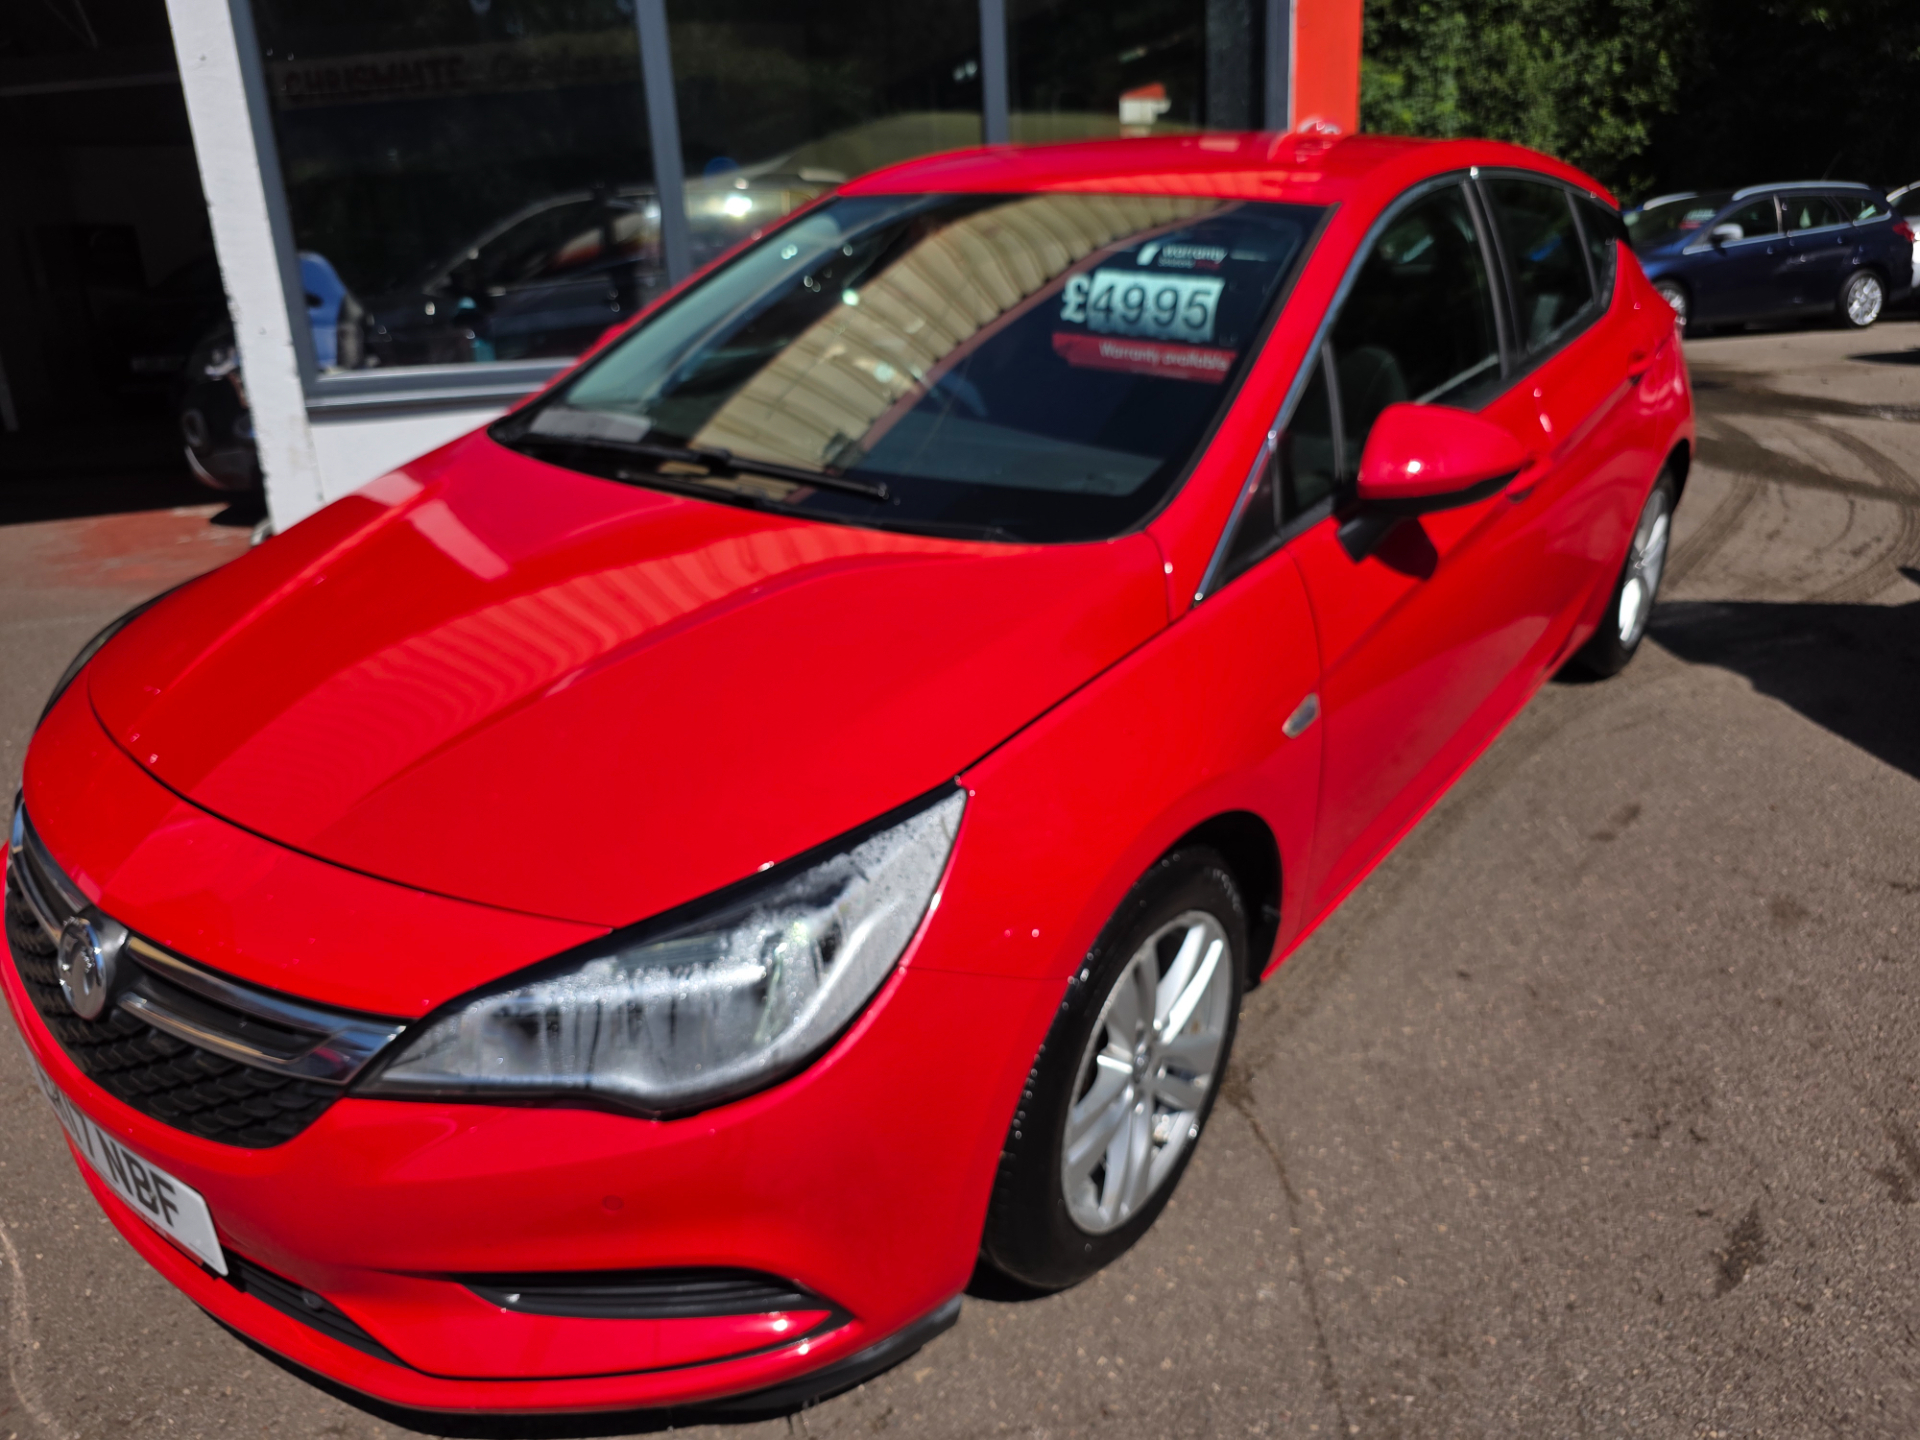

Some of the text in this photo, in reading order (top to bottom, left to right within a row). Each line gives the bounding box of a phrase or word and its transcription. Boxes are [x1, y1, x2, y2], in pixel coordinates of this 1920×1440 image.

[1059, 272, 1213, 330] £4995
[1099, 341, 1160, 366] Warranty
[95, 1127, 179, 1227] NBF
